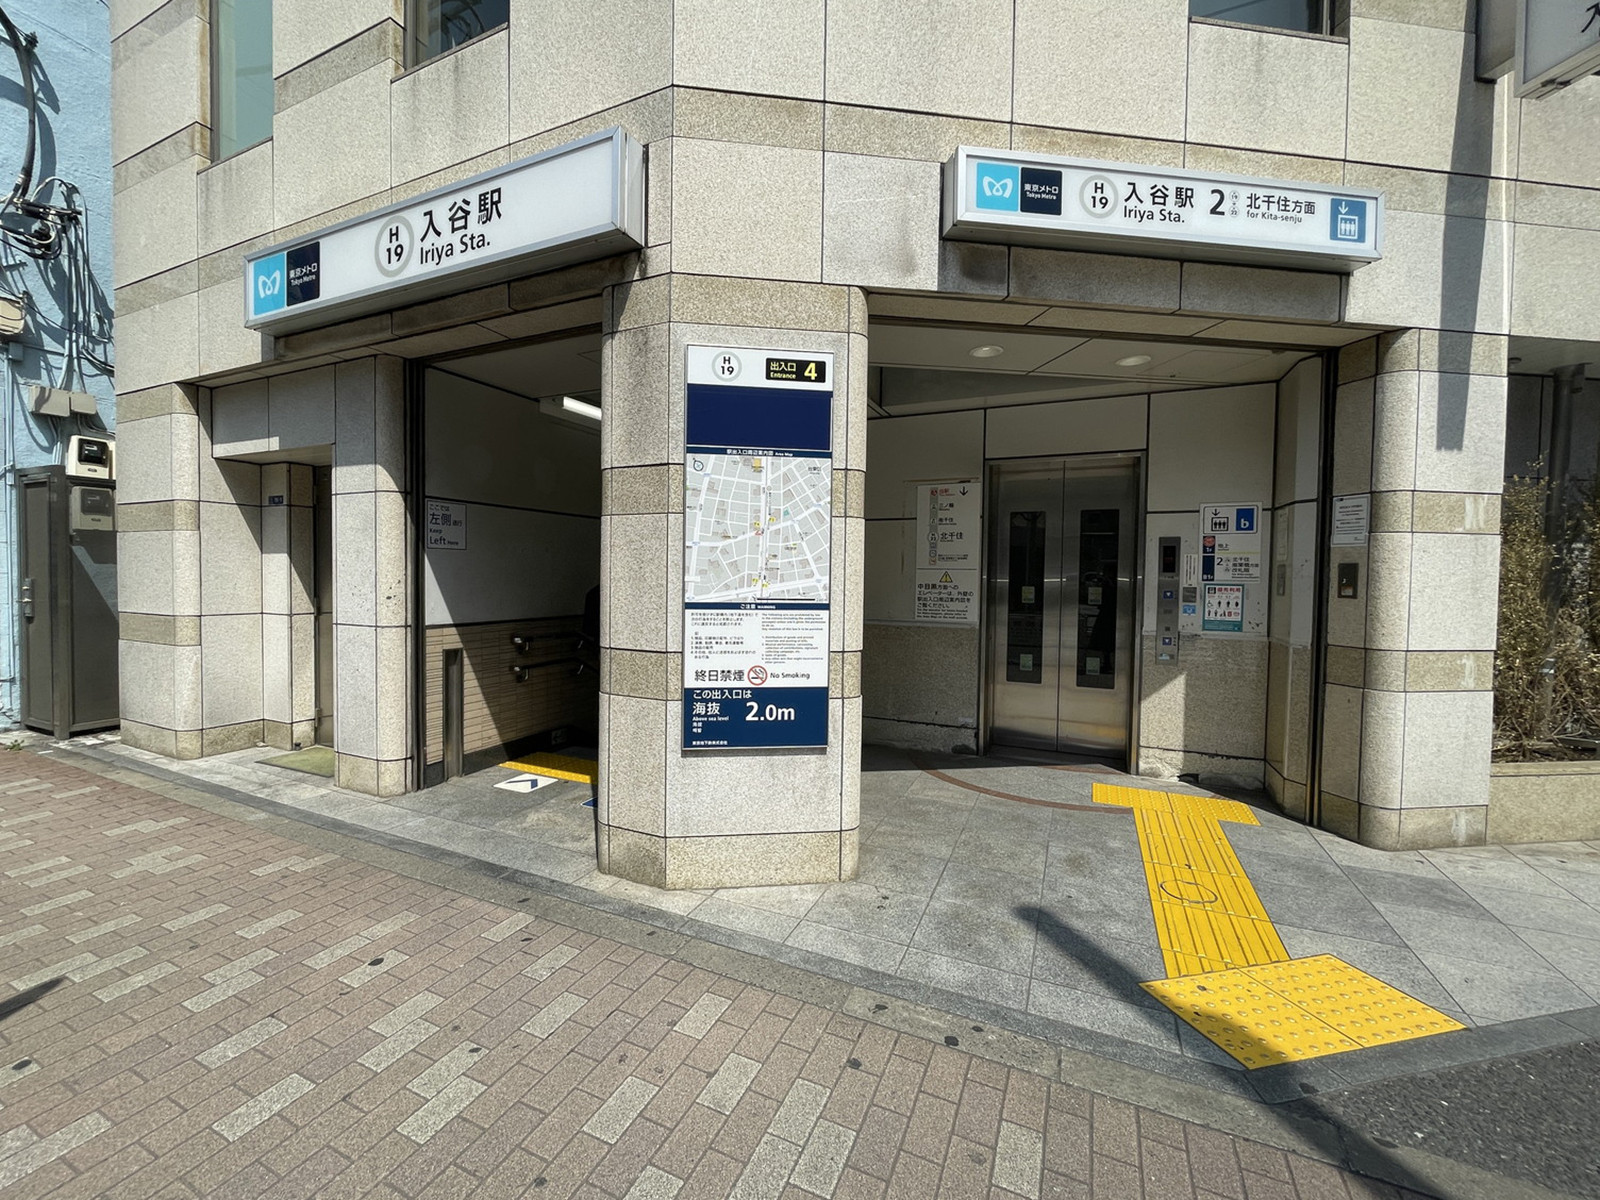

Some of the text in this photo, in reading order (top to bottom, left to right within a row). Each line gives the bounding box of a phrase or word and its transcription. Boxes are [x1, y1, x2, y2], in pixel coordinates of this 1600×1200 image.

[1024, 183, 1059, 194] 東京メトロ
[1094, 182, 1104, 195] H
[1124, 182, 1194, 209] 入谷駅
[1026, 192, 1040, 200] Tokyo
[1091, 196, 1109, 210] 19
[1209, 189, 1225, 216] 2
[1246, 193, 1316, 215] 北千住方面
[420, 188, 502, 243] 入谷駅
[1124, 205, 1185, 223] Iriya Sta.
[1246, 210, 1303, 224] for Kita-senju
[389, 226, 399, 243] H
[386, 243, 404, 264] 19
[420, 233, 491, 266] Iriya Sta.
[289, 262, 318, 279] 東京メトロ
[723, 356, 731, 365] H
[720, 366, 735, 376] 19
[770, 362, 818, 380] 出入口 4
[1241, 518, 1249, 529] b
[430, 536, 446, 545] Left
[940, 532, 964, 540] 北千住
[1217, 557, 1224, 566] 2
[694, 670, 745, 682] 終日禁煙
[781, 672, 810, 680] Smoking
[693, 689, 752, 700] この出入口は
[692, 701, 795, 721] 海抜 2.0m
